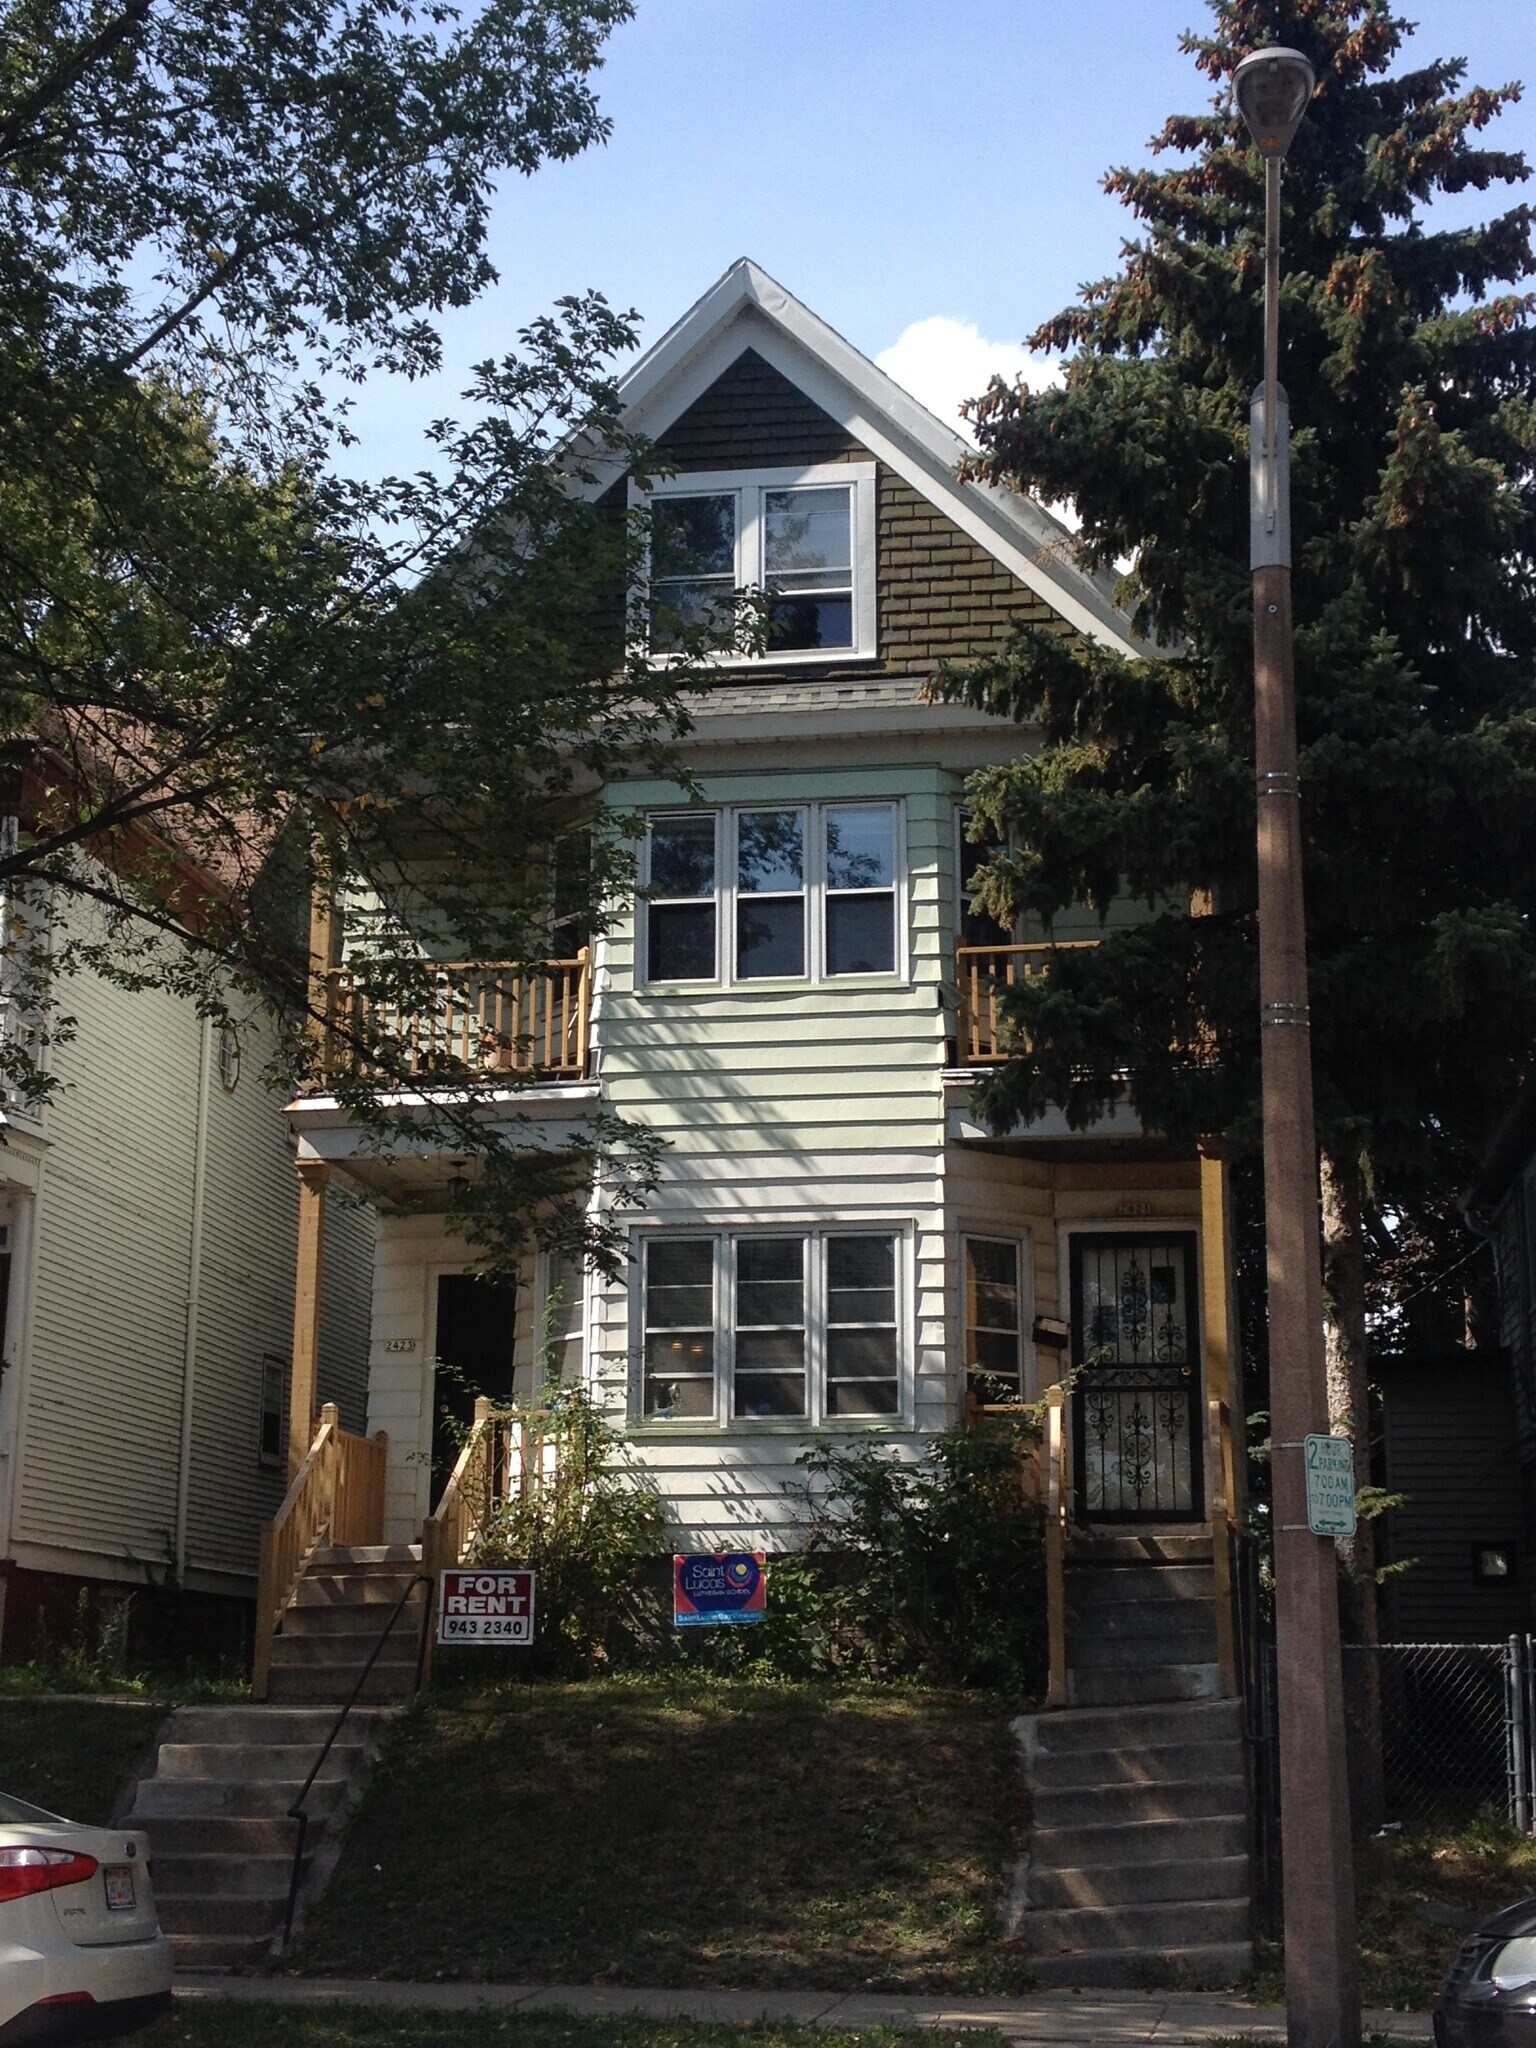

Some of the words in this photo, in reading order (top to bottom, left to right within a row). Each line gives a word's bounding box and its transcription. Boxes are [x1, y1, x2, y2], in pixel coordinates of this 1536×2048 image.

[385, 1340, 415, 1351] 2423
[1308, 1440, 1319, 1470] 2
[1320, 1440, 1342, 1456] HOUR
[1318, 1456, 1352, 1473] PARKING
[692, 1564, 726, 1579] Saint
[458, 1576, 517, 1595] FOR
[685, 1577, 726, 1590] Lucas
[726, 1588, 751, 1596] SCHOOL
[447, 1596, 527, 1614] RENT
[449, 1620, 478, 1634] 943
[483, 1620, 522, 1635] 2340
